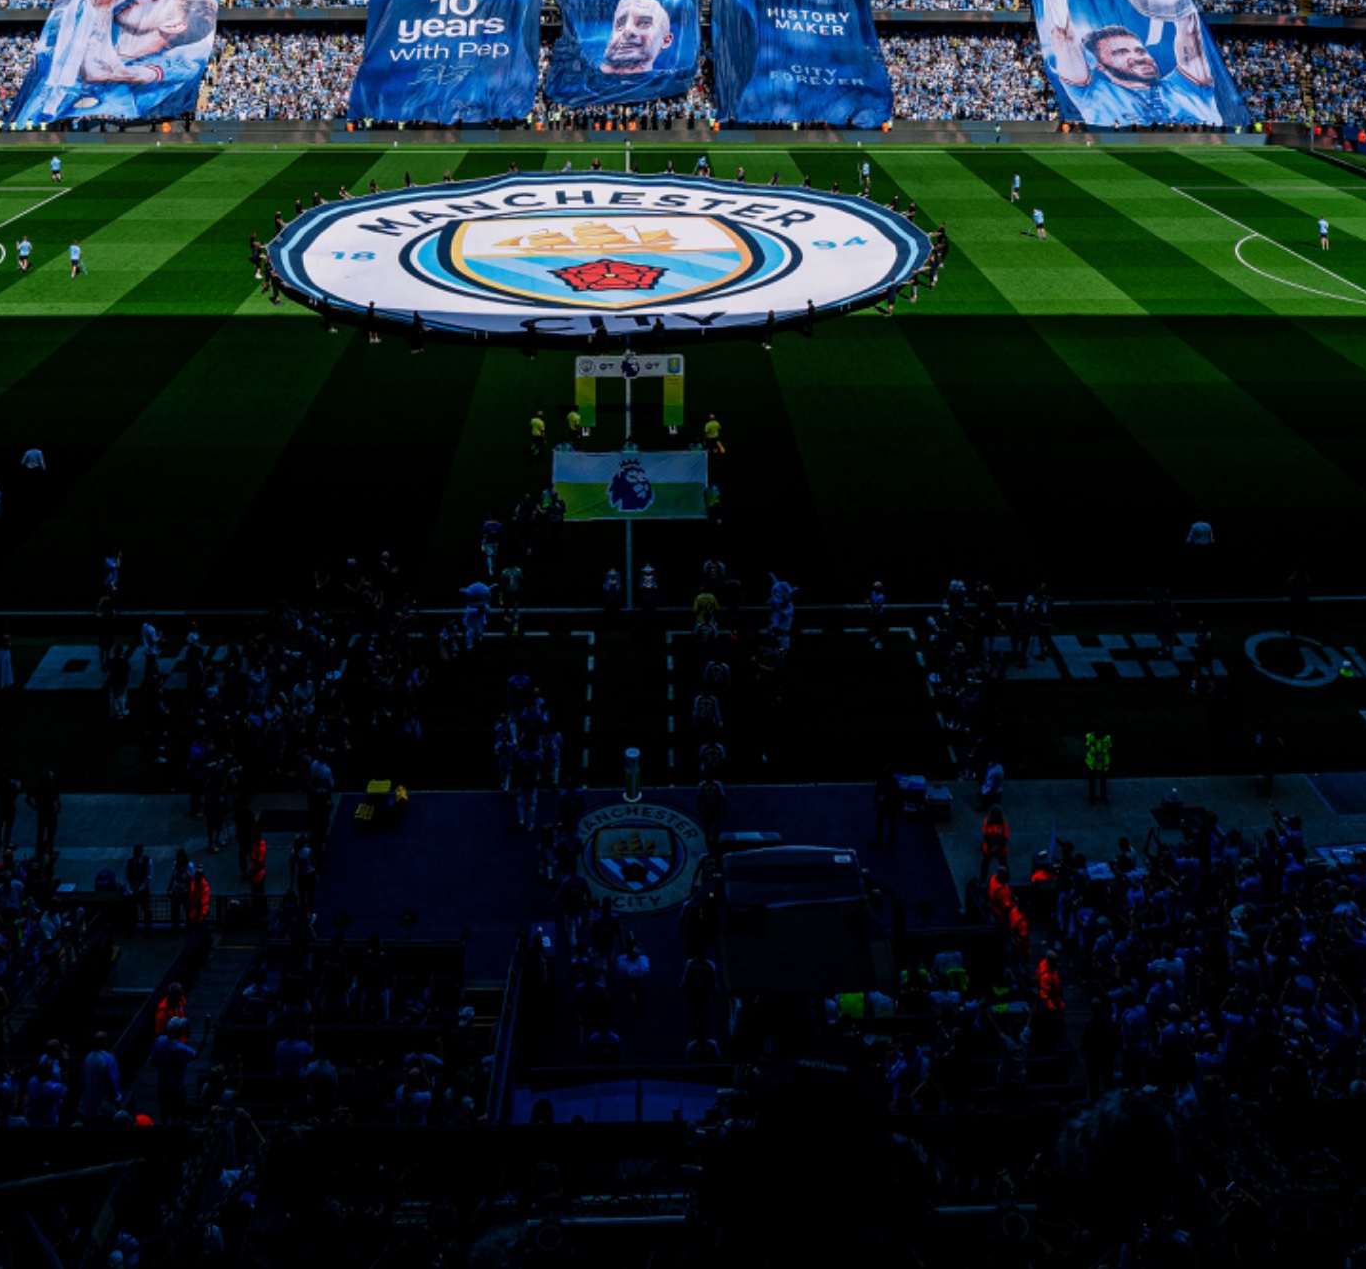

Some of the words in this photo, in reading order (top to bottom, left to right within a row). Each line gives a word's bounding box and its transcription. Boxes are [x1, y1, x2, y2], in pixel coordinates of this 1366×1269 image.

[766, 6, 851, 24] HISTORY
[397, 17, 505, 43] years
[774, 18, 846, 36] MAKER
[389, 42, 449, 62] with
[458, 42, 510, 60] Pep
[769, 70, 865, 86] FOREVER
[790, 64, 838, 78] CITY
[357, 189, 817, 237] MANCHESTER
[811, 235, 868, 250] 94
[329, 249, 376, 262] 18
[580, 806, 699, 839] ANCHESTER
[612, 895, 661, 908] CITY
